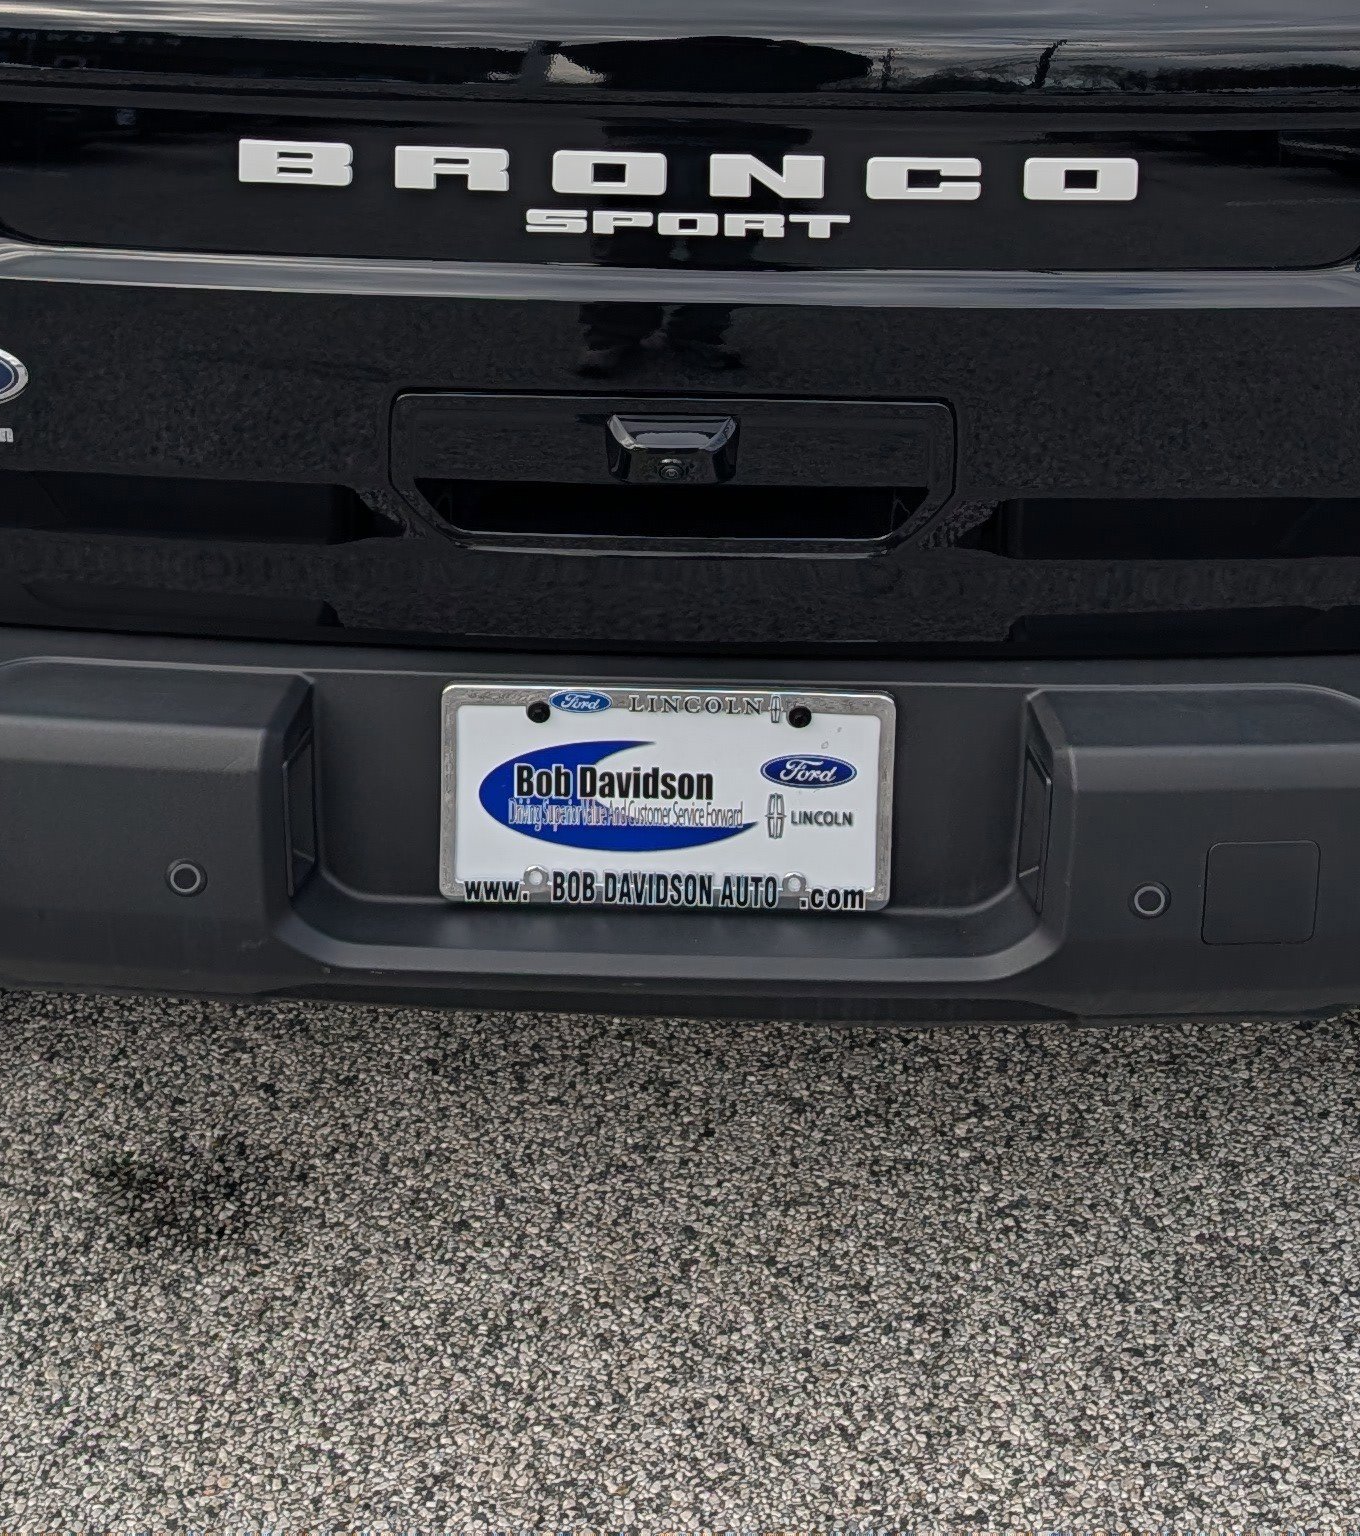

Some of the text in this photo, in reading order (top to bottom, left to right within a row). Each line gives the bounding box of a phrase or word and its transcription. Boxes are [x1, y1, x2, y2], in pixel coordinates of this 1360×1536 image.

[238, 138, 1140, 202] BRONCO
[524, 207, 851, 240] SPORT
[559, 693, 601, 712] Ford
[628, 695, 763, 716] LINCOLN
[516, 764, 715, 801] Bob Davidson
[780, 760, 837, 784] Ford
[673, 801, 704, 827] Service
[706, 801, 743, 828] Forward
[790, 810, 853, 826] LINCOLN
[464, 879, 529, 902] www.
[552, 874, 595, 903] BOB
[604, 873, 712, 906] DAVIDSON
[721, 875, 778, 908] AUTO
